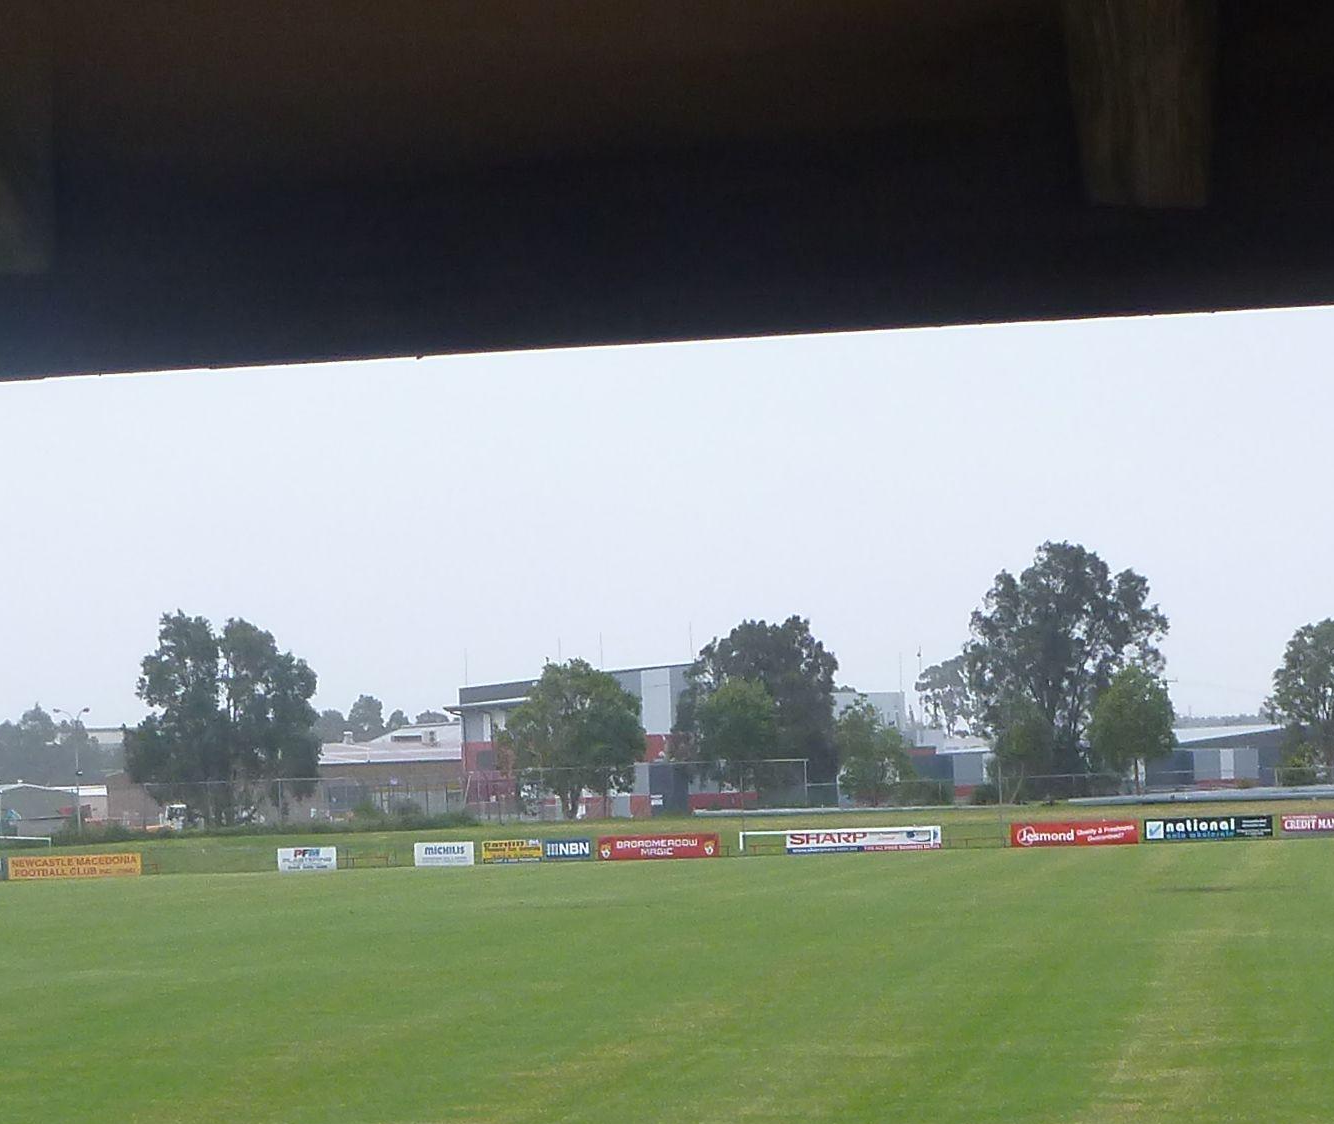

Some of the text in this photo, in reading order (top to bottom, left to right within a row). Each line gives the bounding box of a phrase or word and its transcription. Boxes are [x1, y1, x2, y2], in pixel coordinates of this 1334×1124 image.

[1166, 818, 1235, 832] national
[1284, 819, 1317, 830] CREDIT
[790, 831, 868, 845] SHARP
[1021, 828, 1075, 842] Jesmond
[559, 842, 590, 855] NBN
[616, 838, 698, 849] BROADMEADOW
[293, 848, 320, 858] PFM
[640, 847, 674, 856] MAGIC
[11, 857, 74, 868] NEWCASTLE
[76, 854, 137, 866] MACEDONIA
[14, 867, 67, 877] FOOTBALL
[70, 866, 97, 876] CLUB
